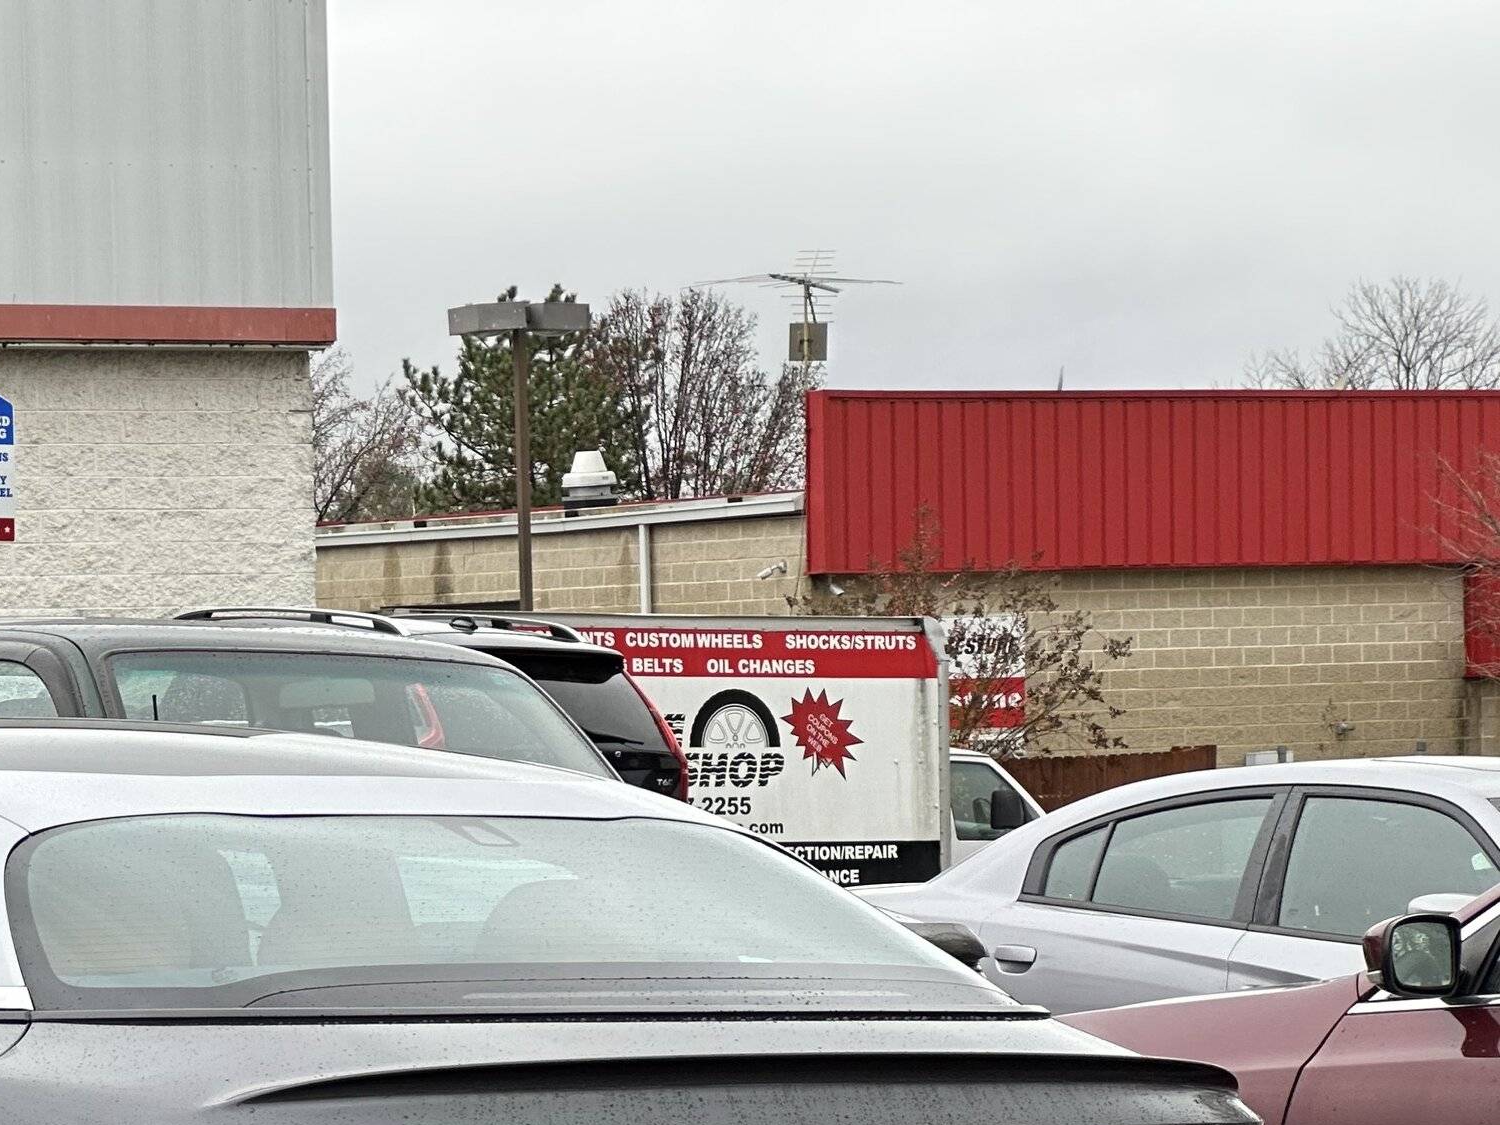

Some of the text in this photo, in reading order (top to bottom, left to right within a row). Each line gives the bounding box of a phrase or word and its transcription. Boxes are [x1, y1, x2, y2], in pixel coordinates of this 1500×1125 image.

[625, 632, 695, 648] CUSTOM
[696, 633, 764, 649] WHEELS
[785, 634, 917, 650] SHOCKS/STRUTS
[632, 657, 684, 673] BELTS
[706, 659, 735, 673] OIL
[737, 659, 816, 674] CHANGES
[808, 714, 838, 744] COUPONS
[820, 714, 833, 728] GET
[685, 752, 785, 788] SHOP
